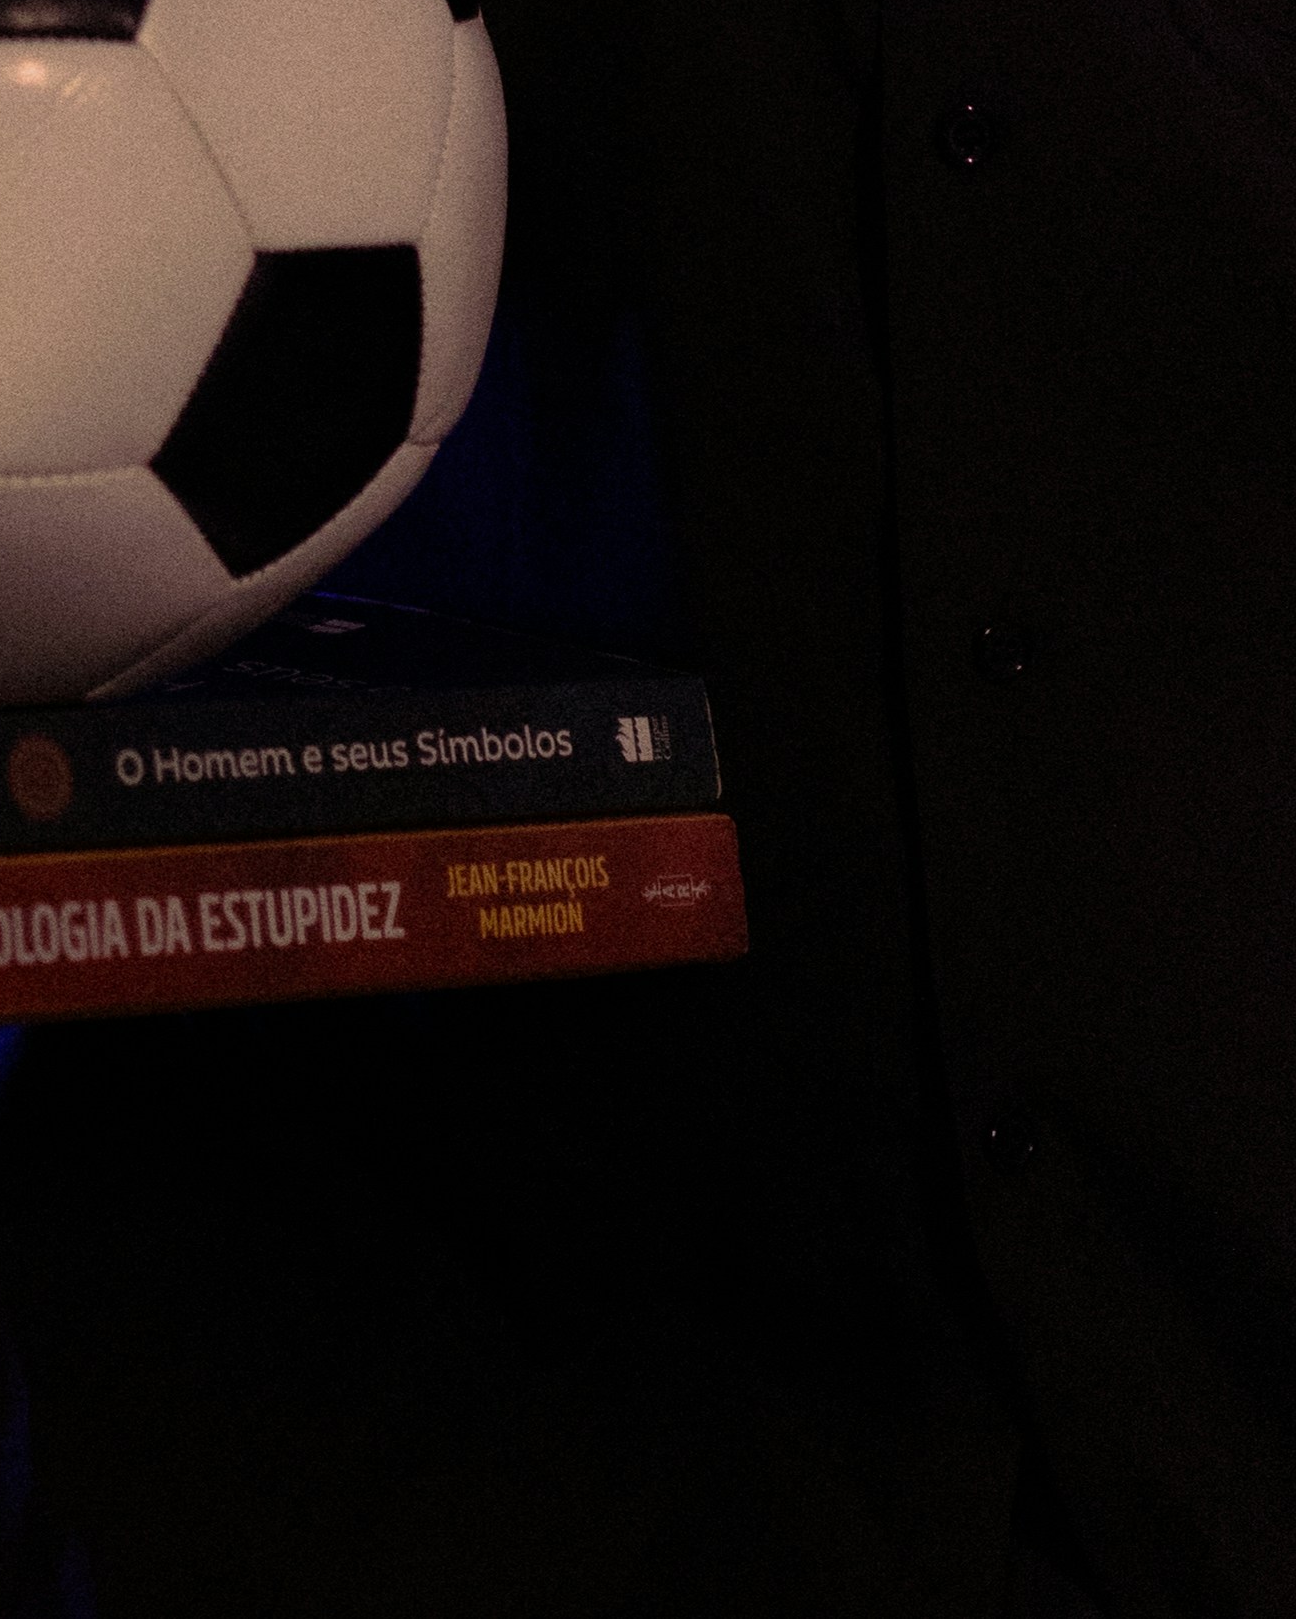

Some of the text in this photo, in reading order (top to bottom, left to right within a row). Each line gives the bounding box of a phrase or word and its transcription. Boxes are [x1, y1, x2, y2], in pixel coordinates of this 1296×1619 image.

[116, 724, 573, 786] O Homem e seus Símbolos
[447, 856, 610, 898] JEAN-FRANÇOIS
[135, 895, 192, 957] DA
[200, 881, 406, 952] ESTUPIDEZ
[480, 902, 585, 939] MARMION
